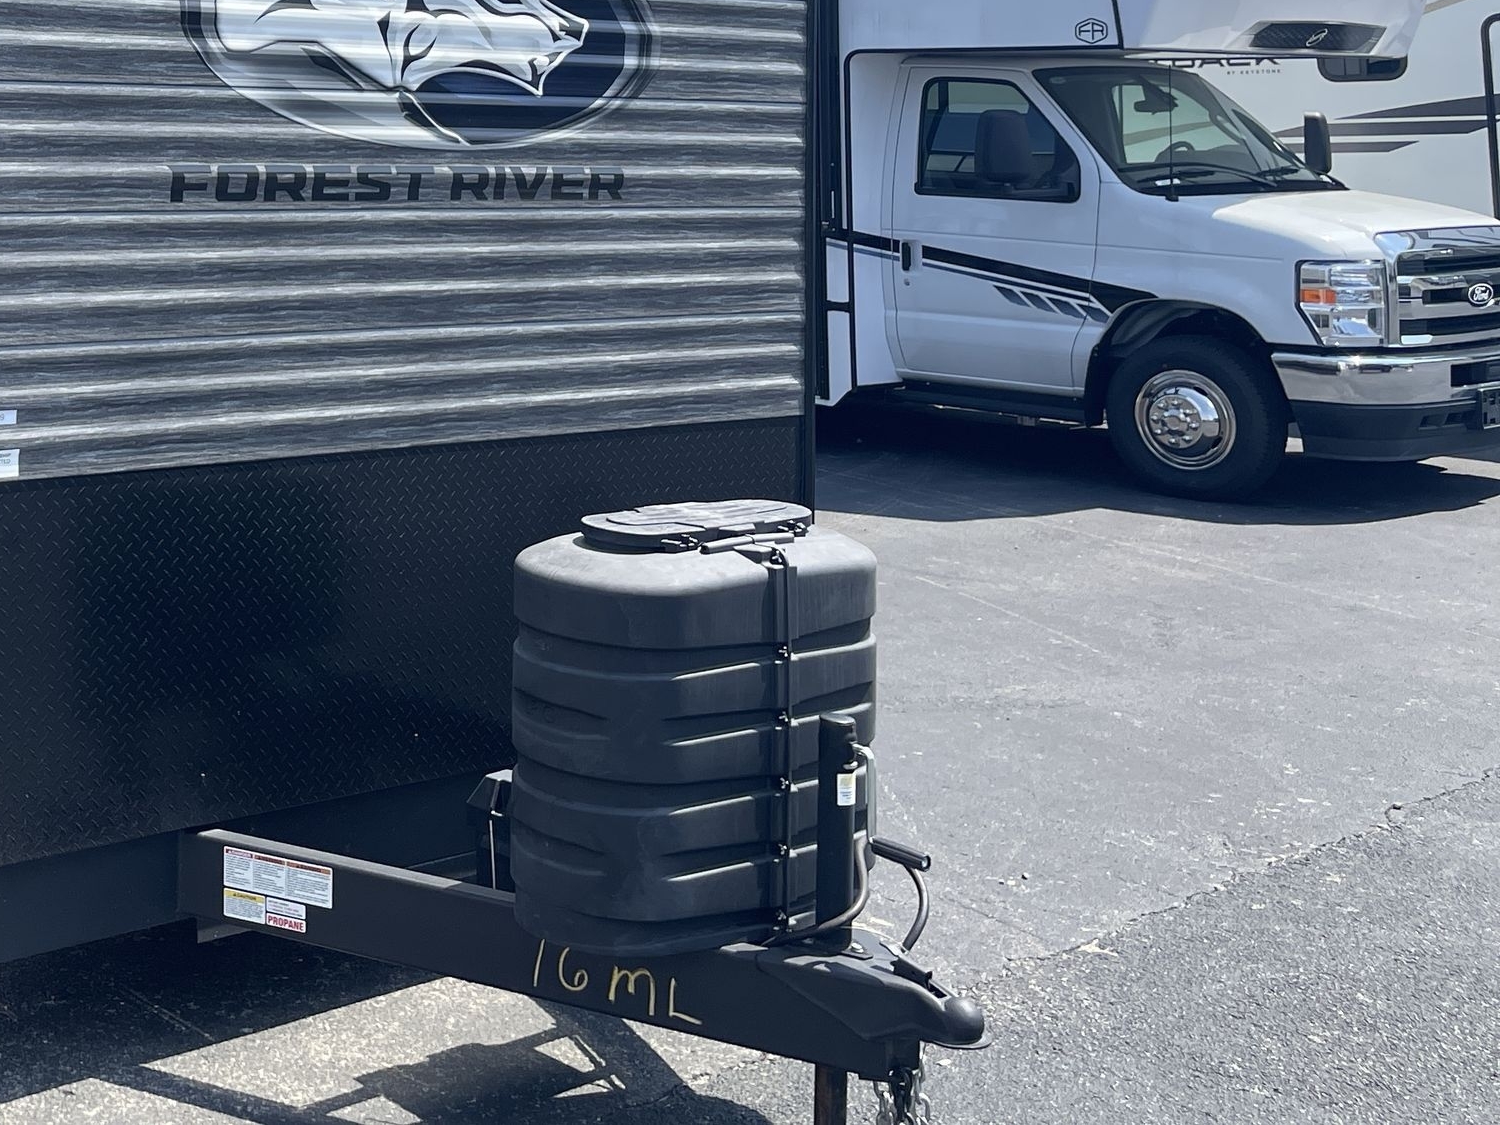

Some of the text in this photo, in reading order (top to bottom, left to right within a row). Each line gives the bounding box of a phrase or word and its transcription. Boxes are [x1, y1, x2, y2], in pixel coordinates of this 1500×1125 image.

[167, 163, 625, 203] FOREST RIVER
[267, 915, 305, 931] PROPANE
[533, 938, 588, 991] 16
